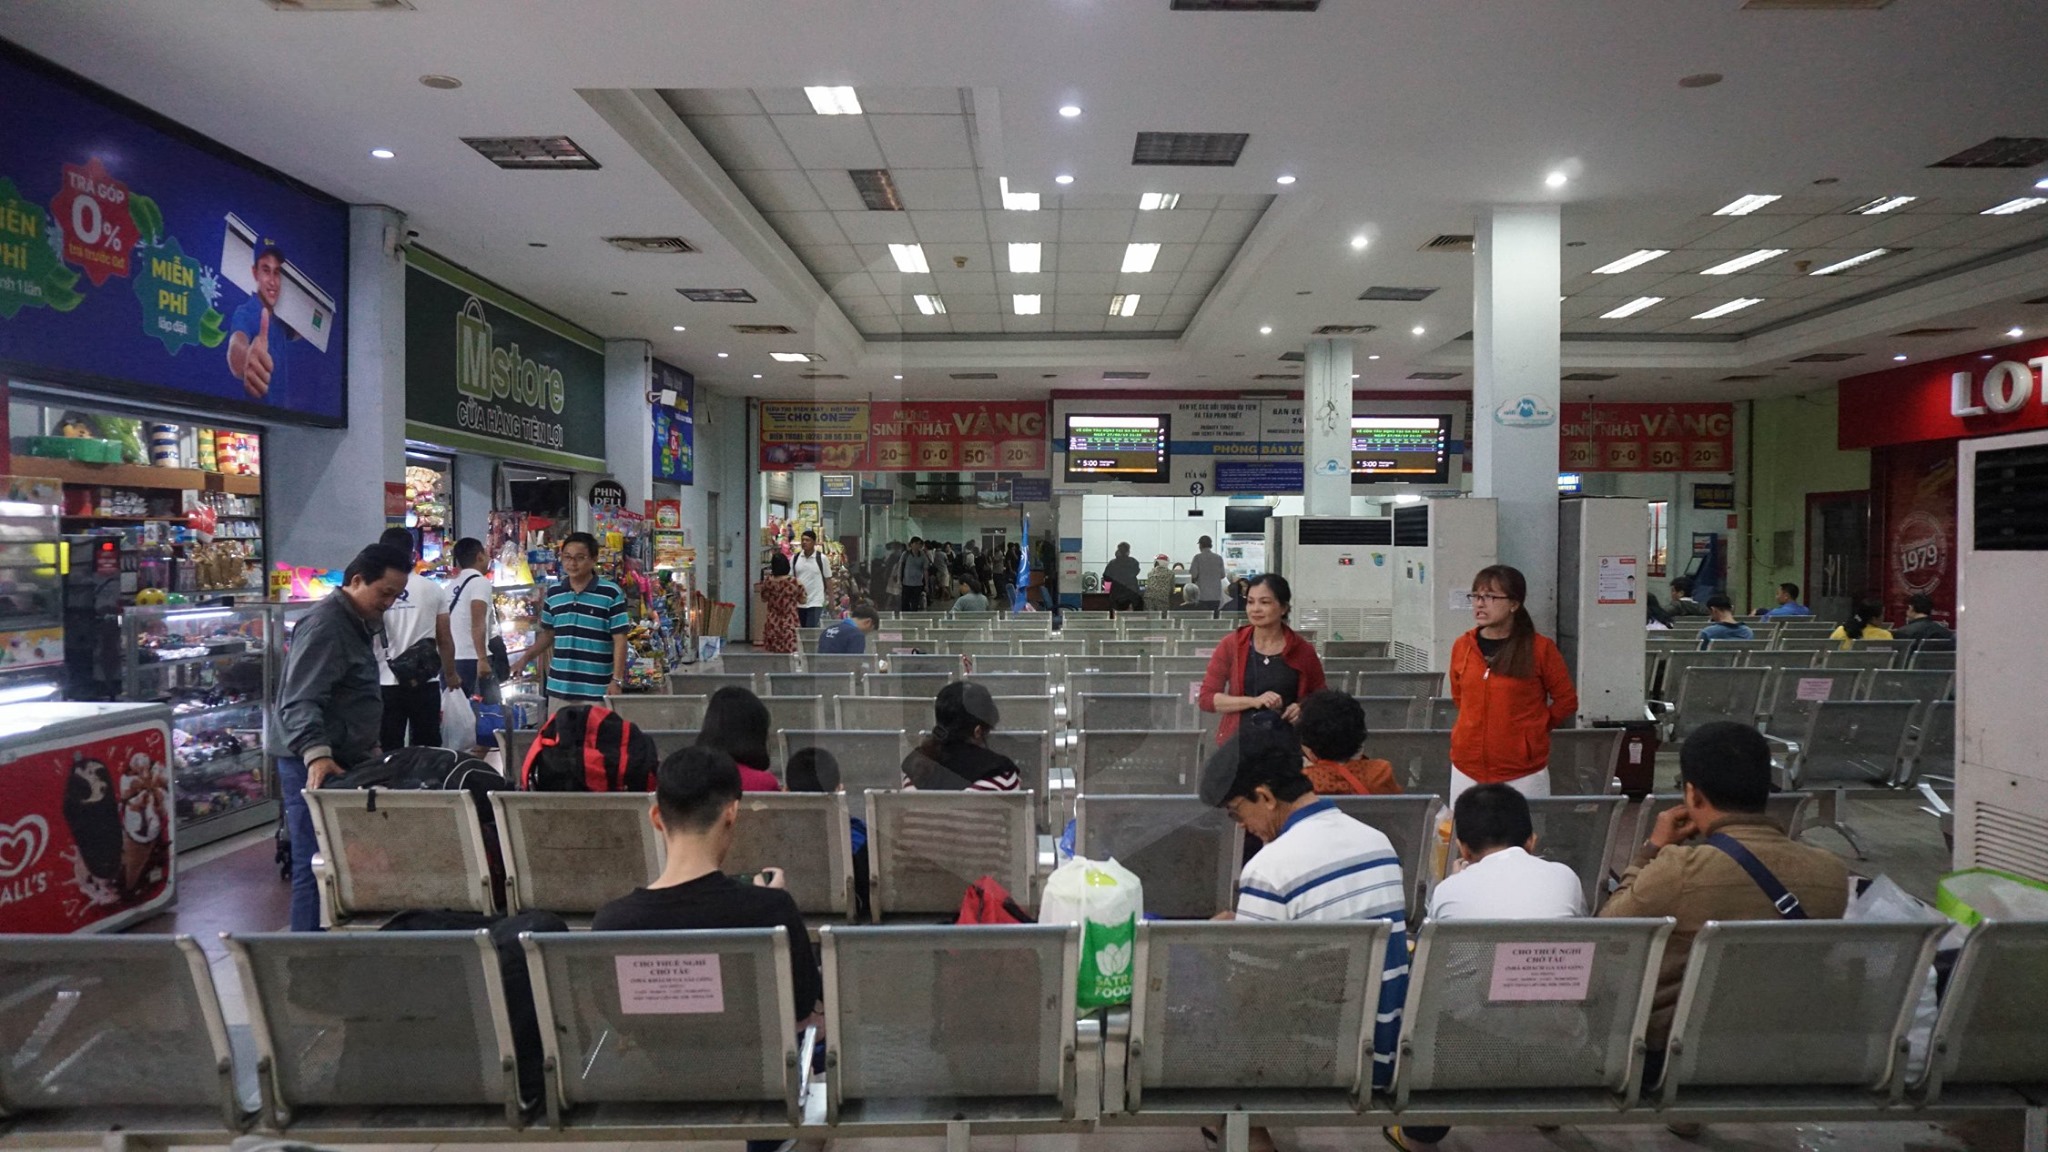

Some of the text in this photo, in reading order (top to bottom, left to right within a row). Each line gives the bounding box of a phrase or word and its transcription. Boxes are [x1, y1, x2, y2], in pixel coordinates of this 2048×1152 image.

[152, 255, 194, 289] MIỄN
[158, 289, 189, 316] PHÍ
[486, 405, 520, 438] HÀNG
[872, 423, 908, 436] SINH
[952, 405, 1042, 436] VÀNG
[1640, 406, 1730, 437] VÀNG
[1361, 460, 1377, 468] 5:00
[594, 487, 621, 497] PHIN
[1901, 544, 1938, 574] 1979
[0, 872, 47, 907] ALL'S
